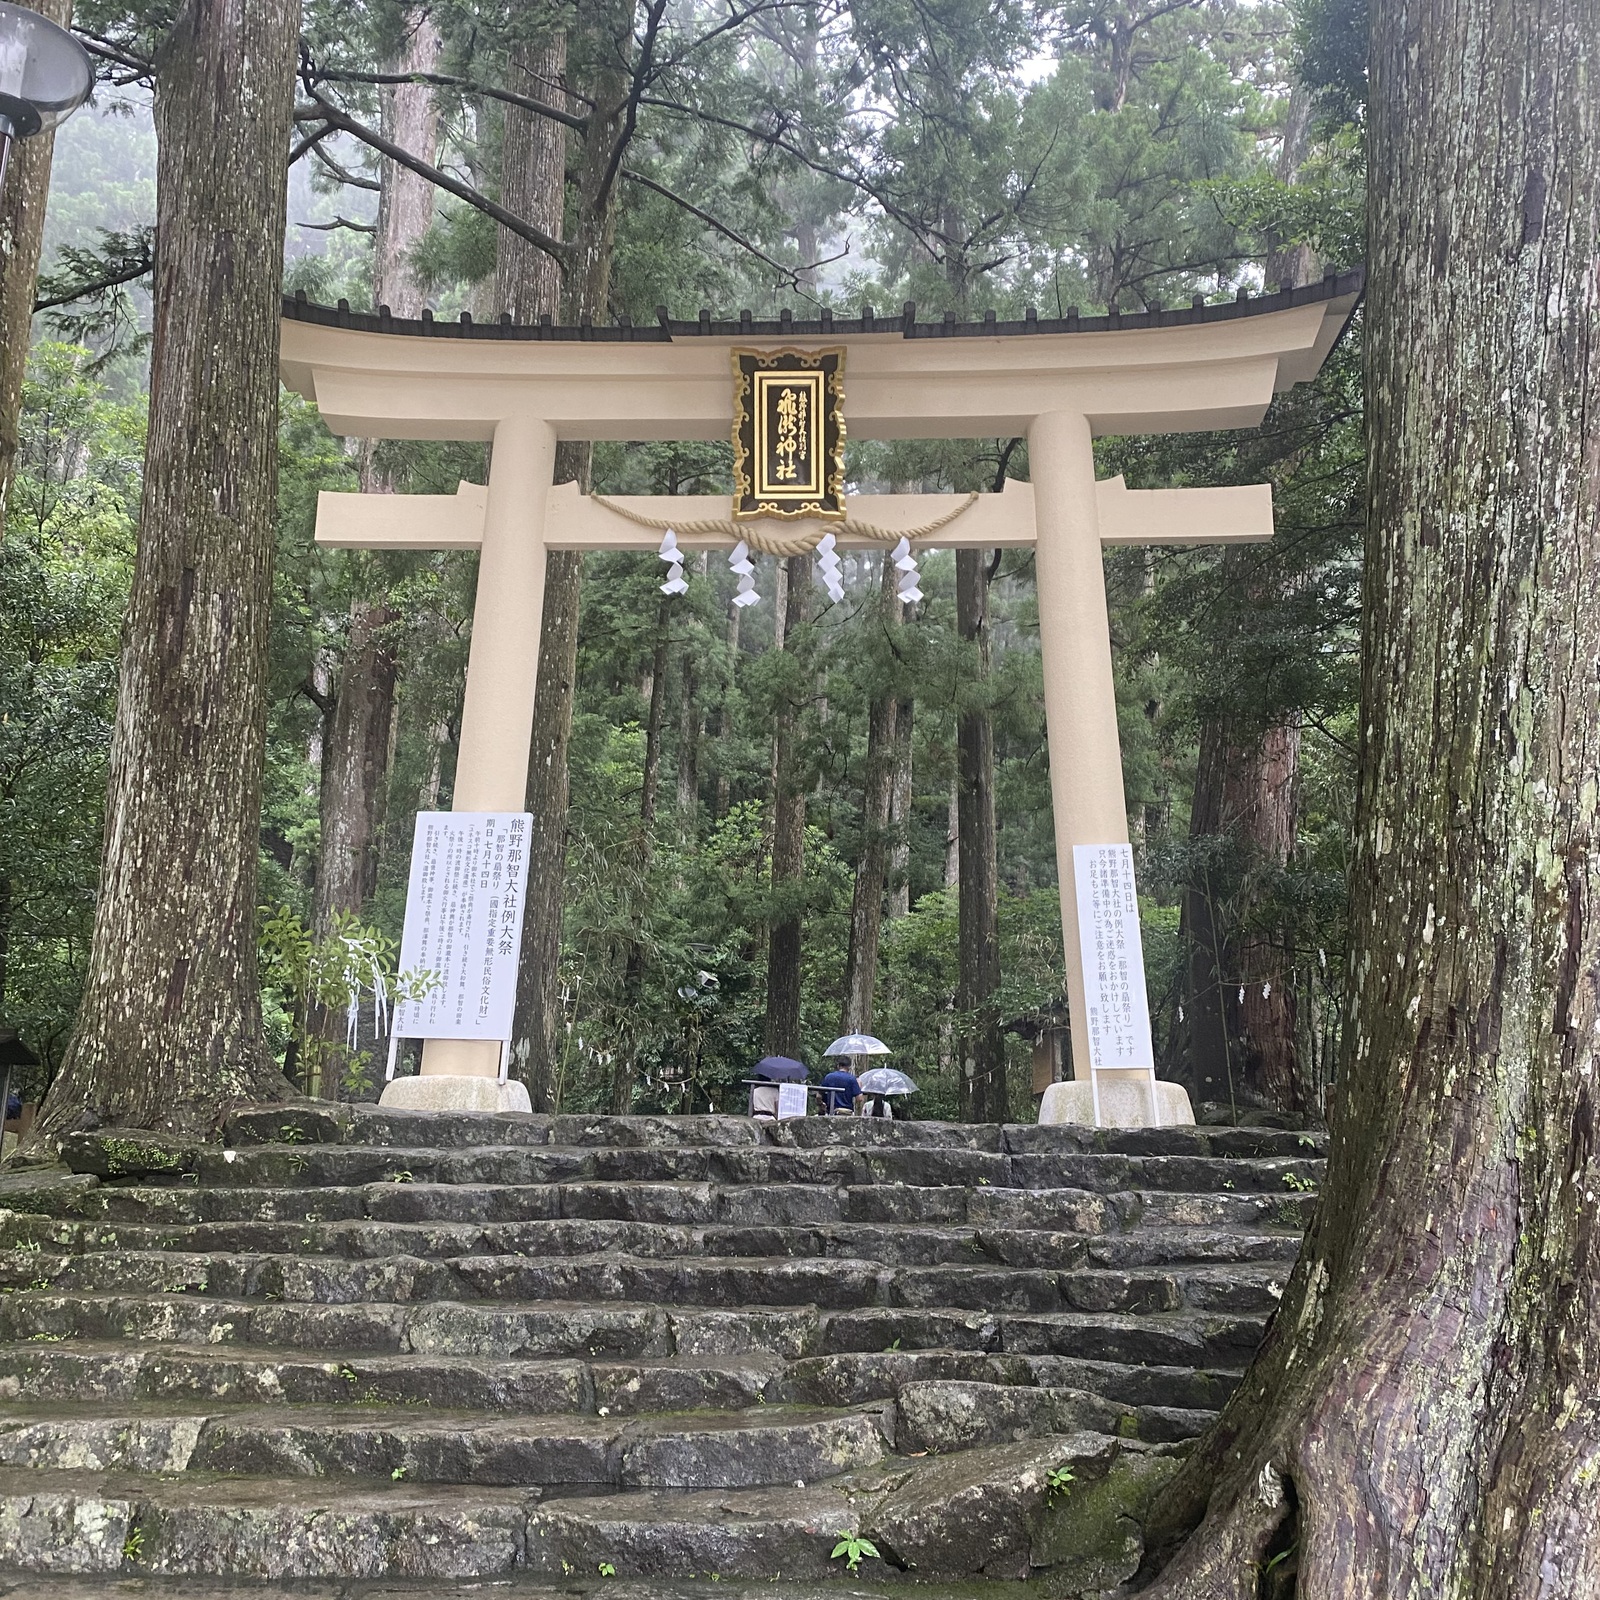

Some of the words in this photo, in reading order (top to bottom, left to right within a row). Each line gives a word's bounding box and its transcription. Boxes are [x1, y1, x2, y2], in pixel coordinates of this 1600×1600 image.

[496, 817, 525, 956] 熊野那智大社例大祭
[1088, 859, 1111, 1035] お足もと等にご注意をお願い致します
[1119, 847, 1135, 913] 七月十四日は
[1098, 849, 1124, 1057] 只今諸準備中の為ご迷惑をおかけしています
[1089, 1006, 1102, 1066] 熊野那智大社
